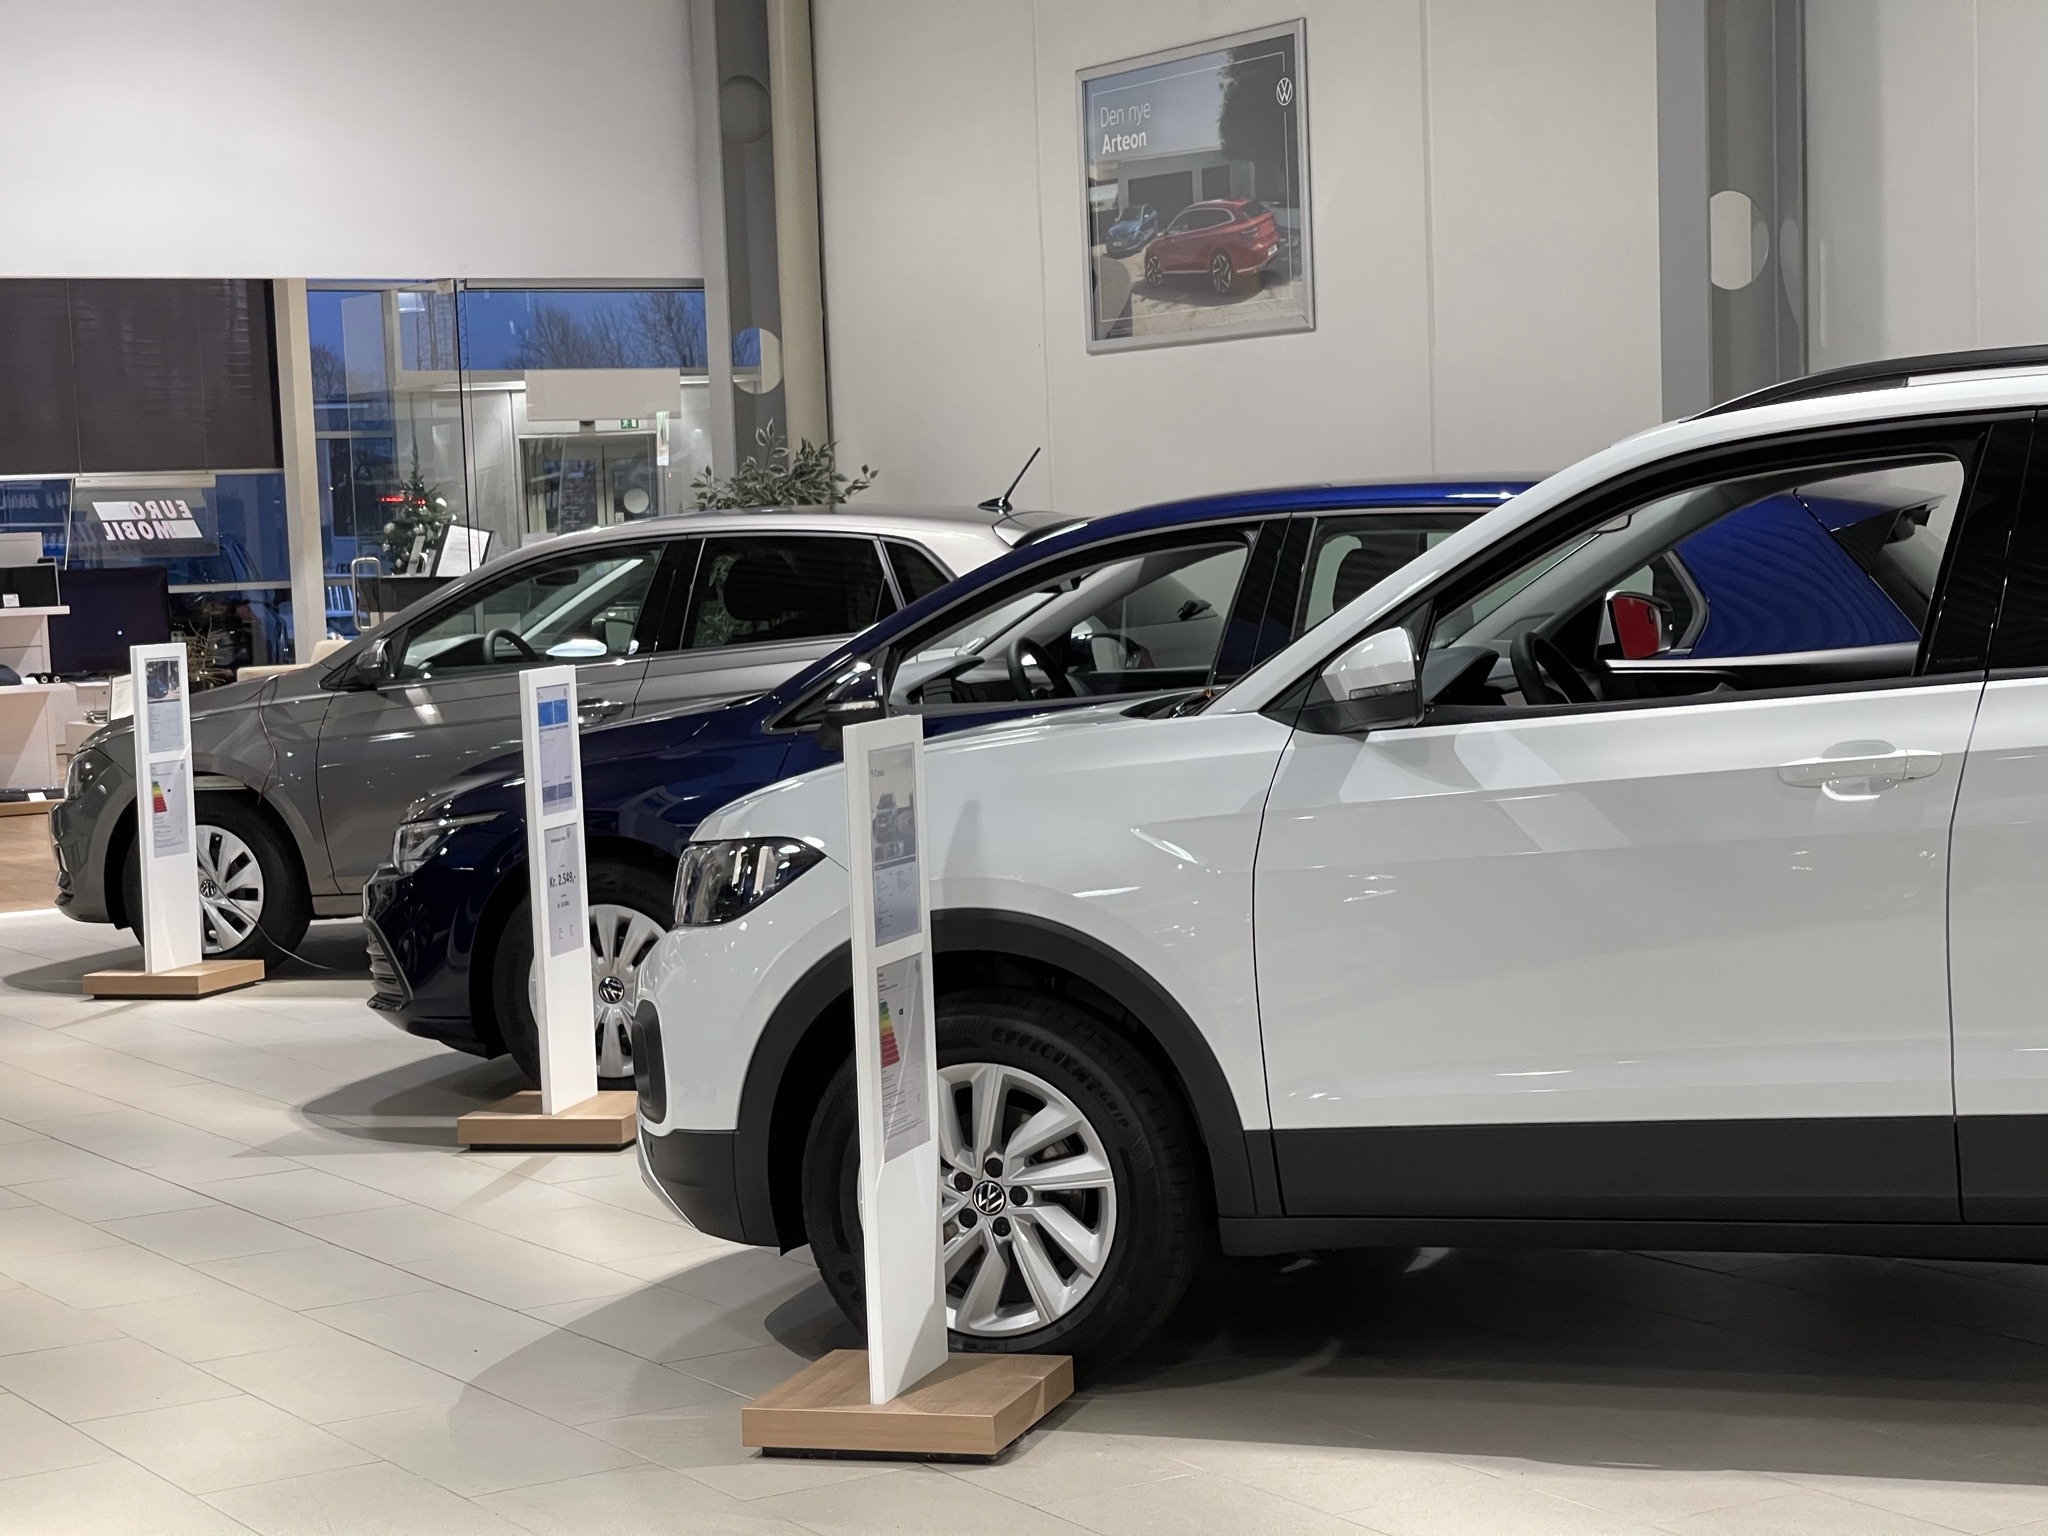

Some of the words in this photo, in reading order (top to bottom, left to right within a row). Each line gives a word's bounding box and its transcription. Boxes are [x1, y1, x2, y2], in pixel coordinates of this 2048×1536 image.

[1100, 106, 1125, 127] Den
[1128, 103, 1151, 126] nye
[1102, 131, 1147, 155] Arteon
[549, 876, 557, 888] Kr.
